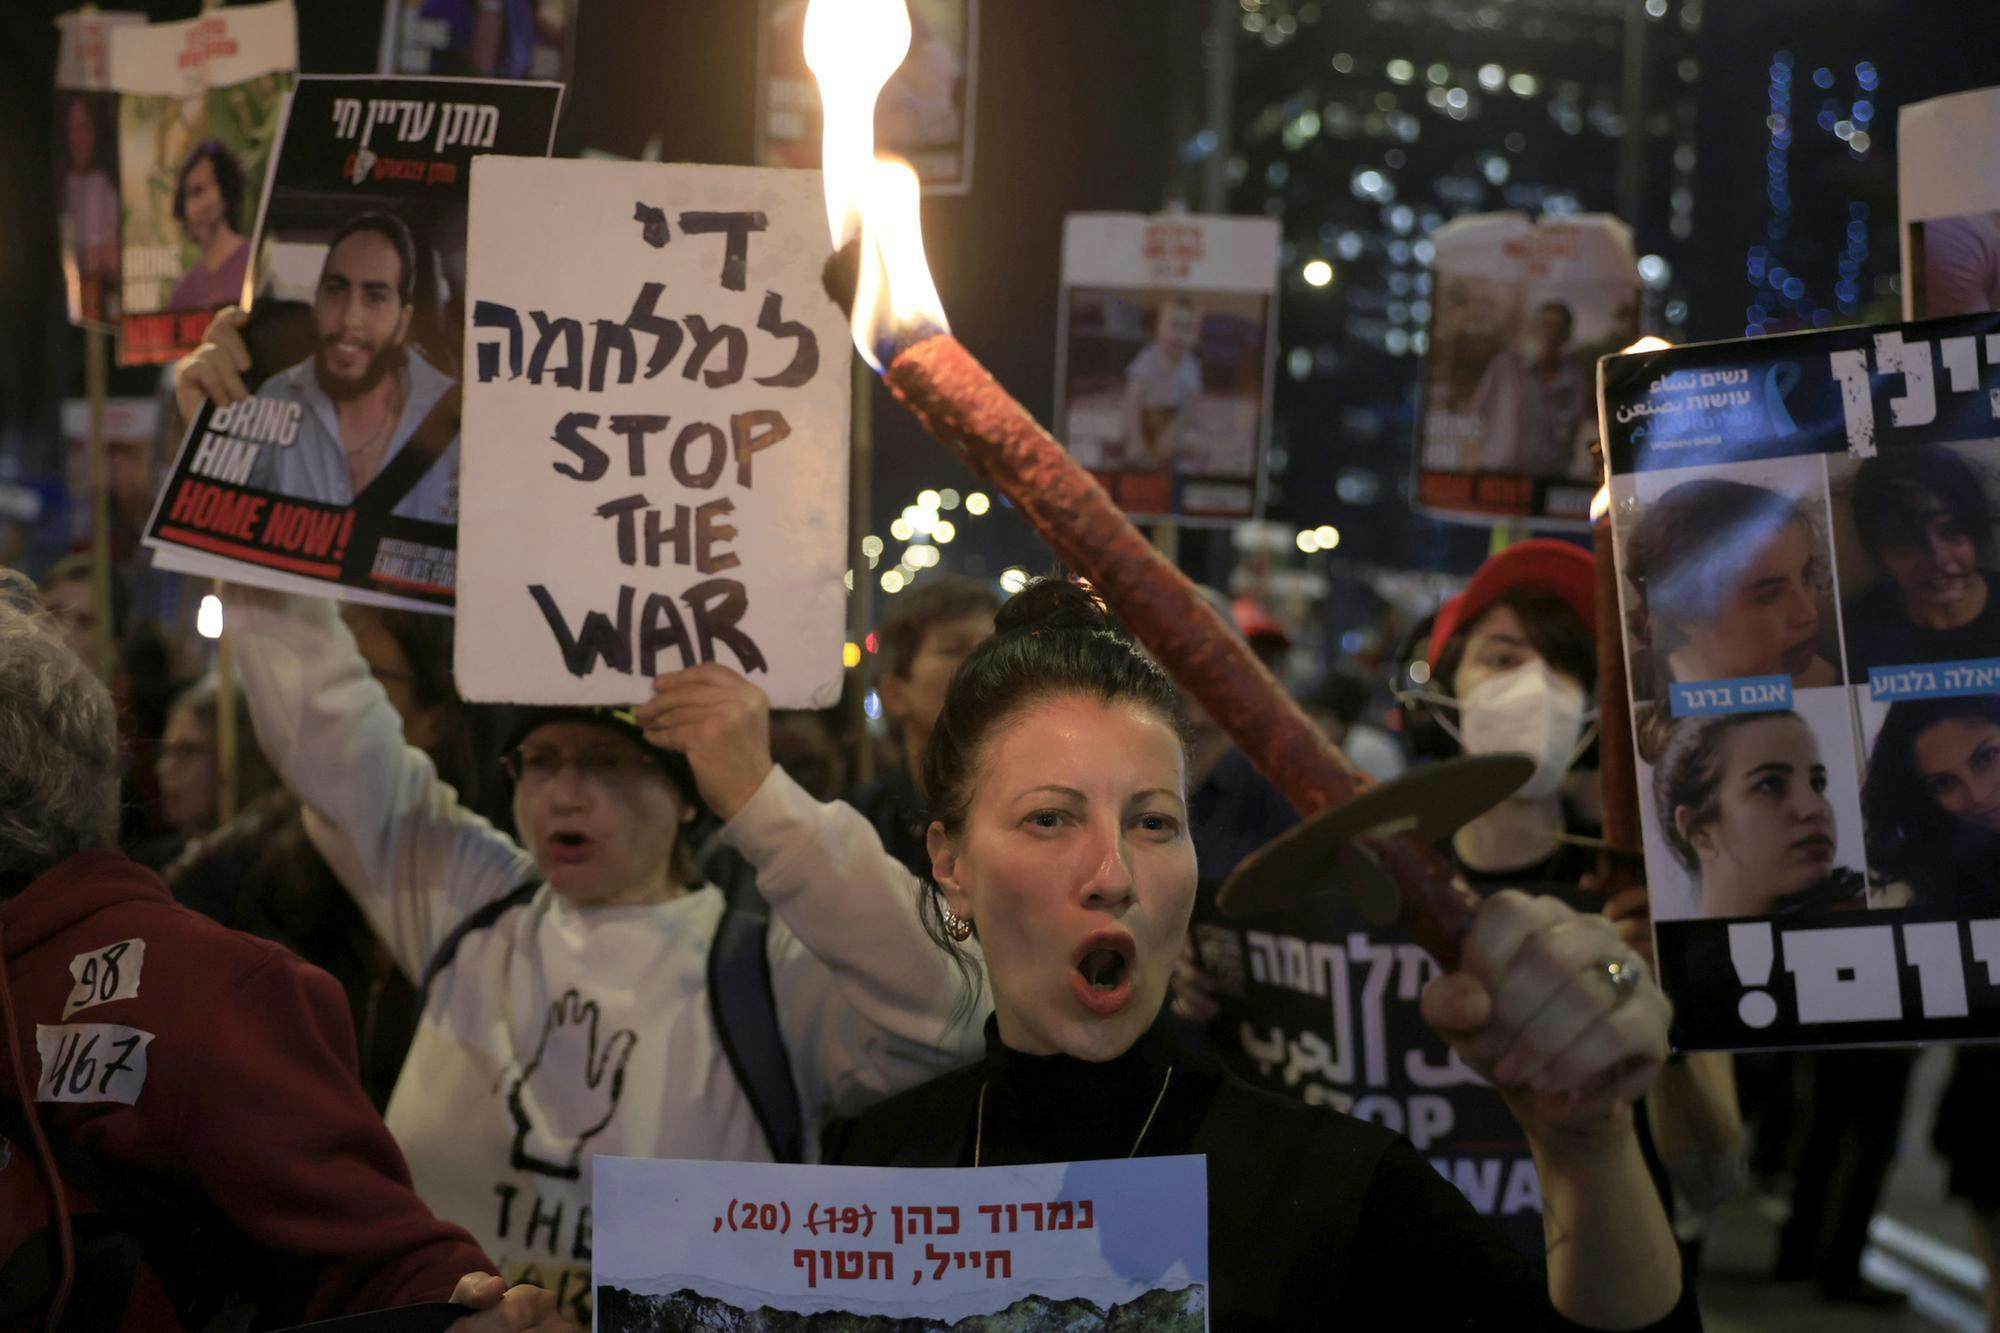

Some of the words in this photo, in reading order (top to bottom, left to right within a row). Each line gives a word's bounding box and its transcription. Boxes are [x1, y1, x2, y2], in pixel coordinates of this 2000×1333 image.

[332, 98, 361, 139] חי
[359, 99, 436, 152] עדיין
[435, 102, 499, 153] מתן
[633, 201, 768, 291] די
[473, 283, 820, 392] למלחמה
[1701, 369, 1748, 388] נשים
[1829, 331, 2000, 459] ילן
[208, 396, 302, 447] BRING
[190, 431, 259, 485] HIM
[550, 410, 792, 489] STOP
[170, 479, 267, 540] HOME
[261, 502, 356, 560] NOW!
[593, 494, 741, 574] THE
[527, 578, 767, 678] WAR
[1680, 686, 1734, 709] ברגר
[1741, 682, 1786, 705] אגם
[1872, 669, 1937, 696] גלבוע
[73, 943, 130, 1006] 98
[48, 1033, 141, 1097] 467
[1427, 1158, 1543, 1215] WA
[713, 1199, 791, 1234] (20),
[891, 1205, 960, 1244] כהן
[978, 1199, 1094, 1234] נמרוד
[793, 1248, 894, 1288] חטוף
[912, 1243, 1012, 1286] חייל,
